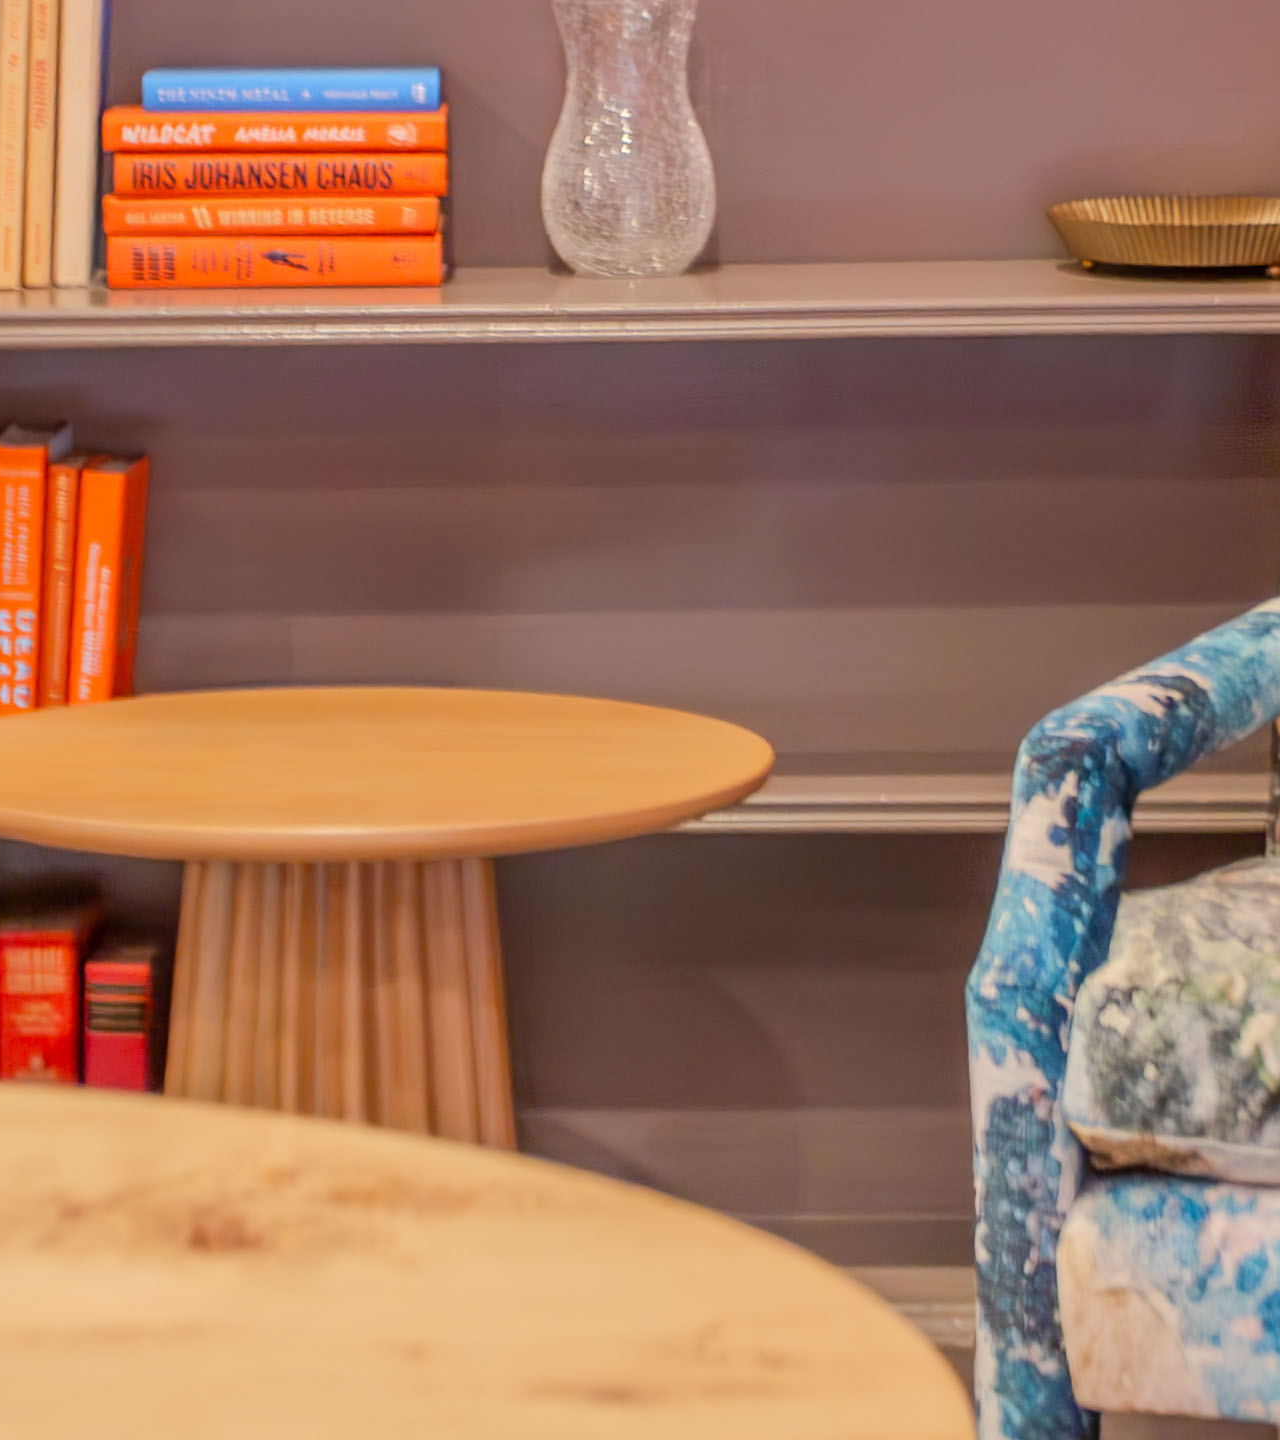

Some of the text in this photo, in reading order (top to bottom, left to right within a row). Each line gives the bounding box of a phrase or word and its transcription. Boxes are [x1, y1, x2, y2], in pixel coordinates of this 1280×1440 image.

[121, 124, 367, 145] WILDCAT AMELIA MORRIS
[131, 160, 394, 190] IRIS JOHANSEN CHAOS
[218, 209, 283, 226] WINNING
[287, 208, 305, 225] IN
[308, 207, 377, 225] REVERSE
[14, 609, 35, 709] DEAD
